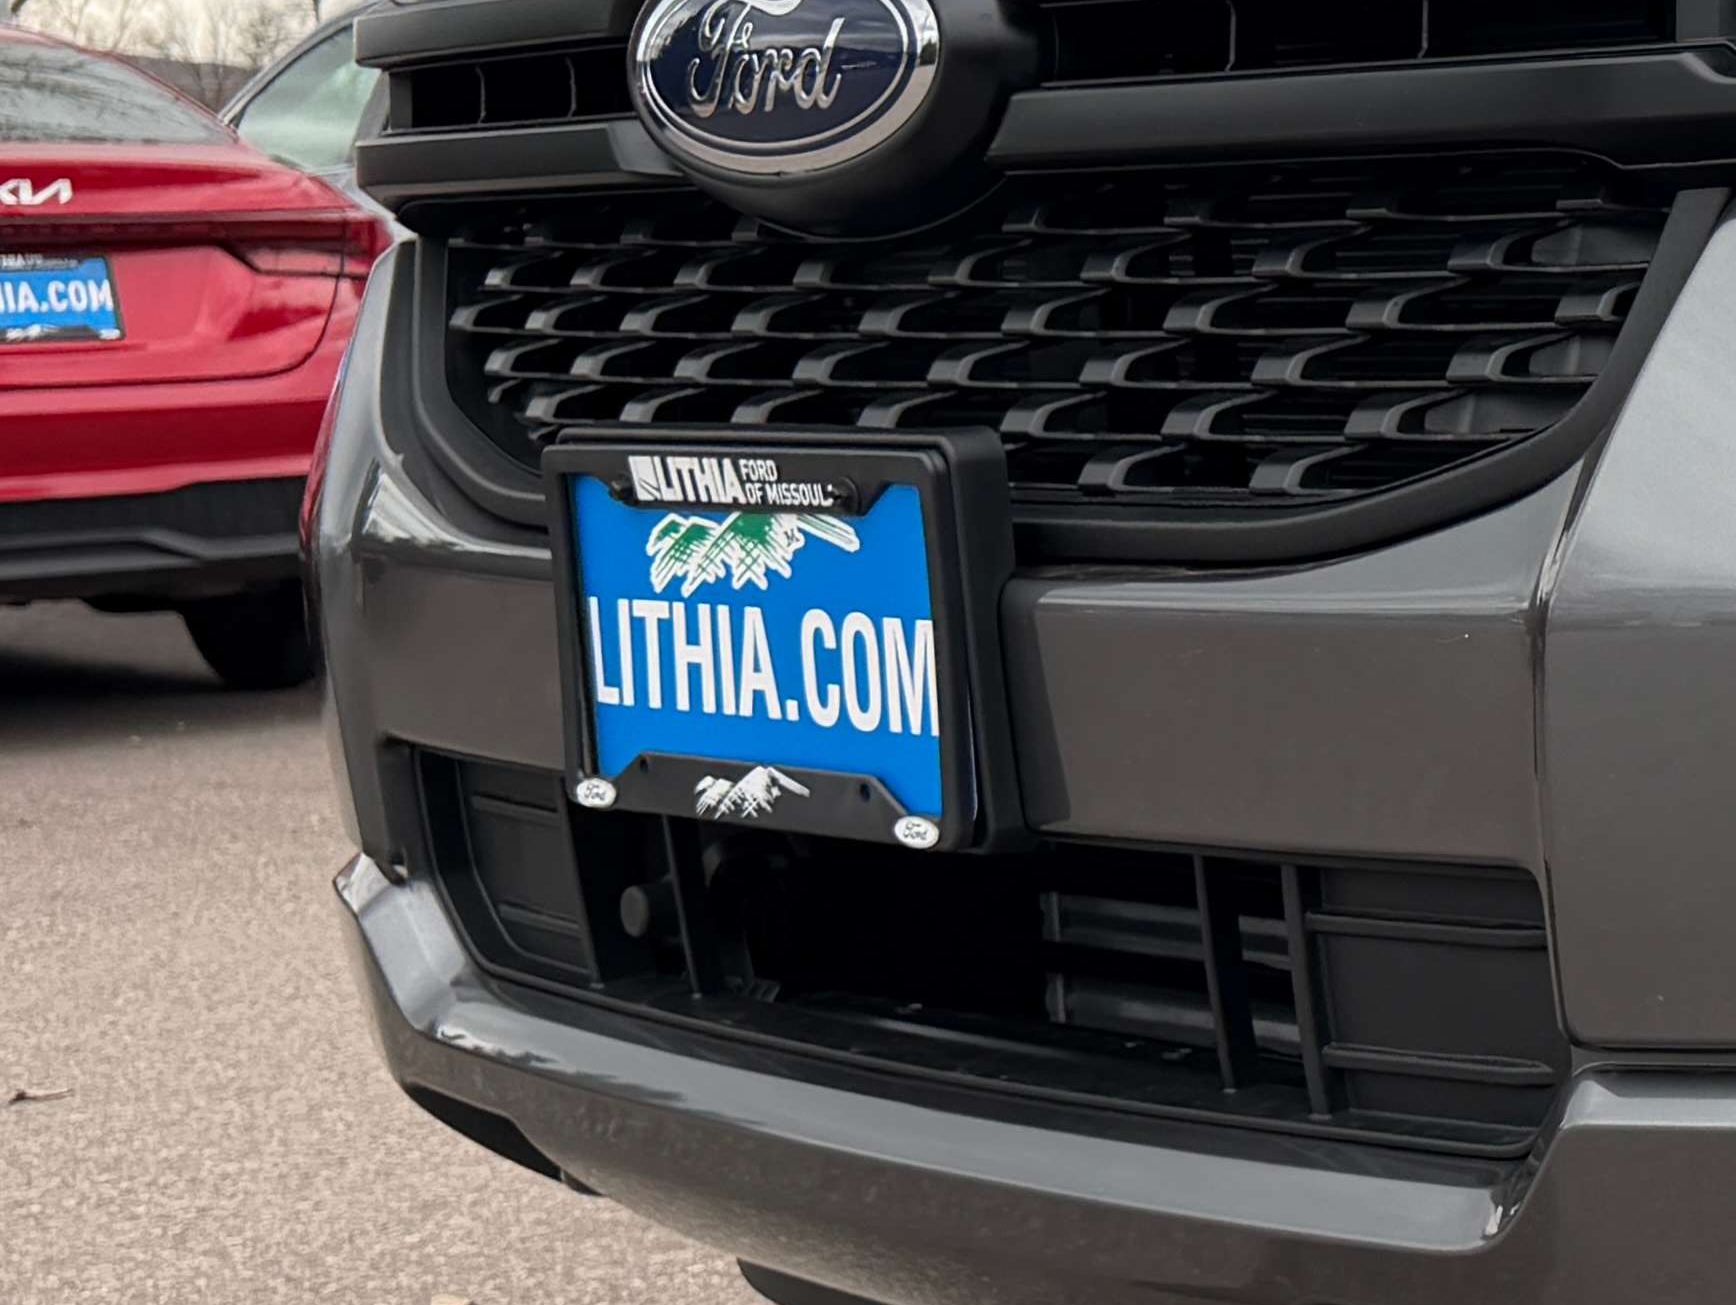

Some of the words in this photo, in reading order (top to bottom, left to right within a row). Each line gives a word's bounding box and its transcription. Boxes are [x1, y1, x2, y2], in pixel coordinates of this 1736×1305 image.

[0, 280, 114, 313] IA.COM
[652, 456, 747, 505] LITHIA
[738, 458, 778, 482] FORD
[744, 482, 767, 505] OF
[767, 484, 836, 507] MISSOUL
[588, 596, 940, 738] LITHIA.COM
